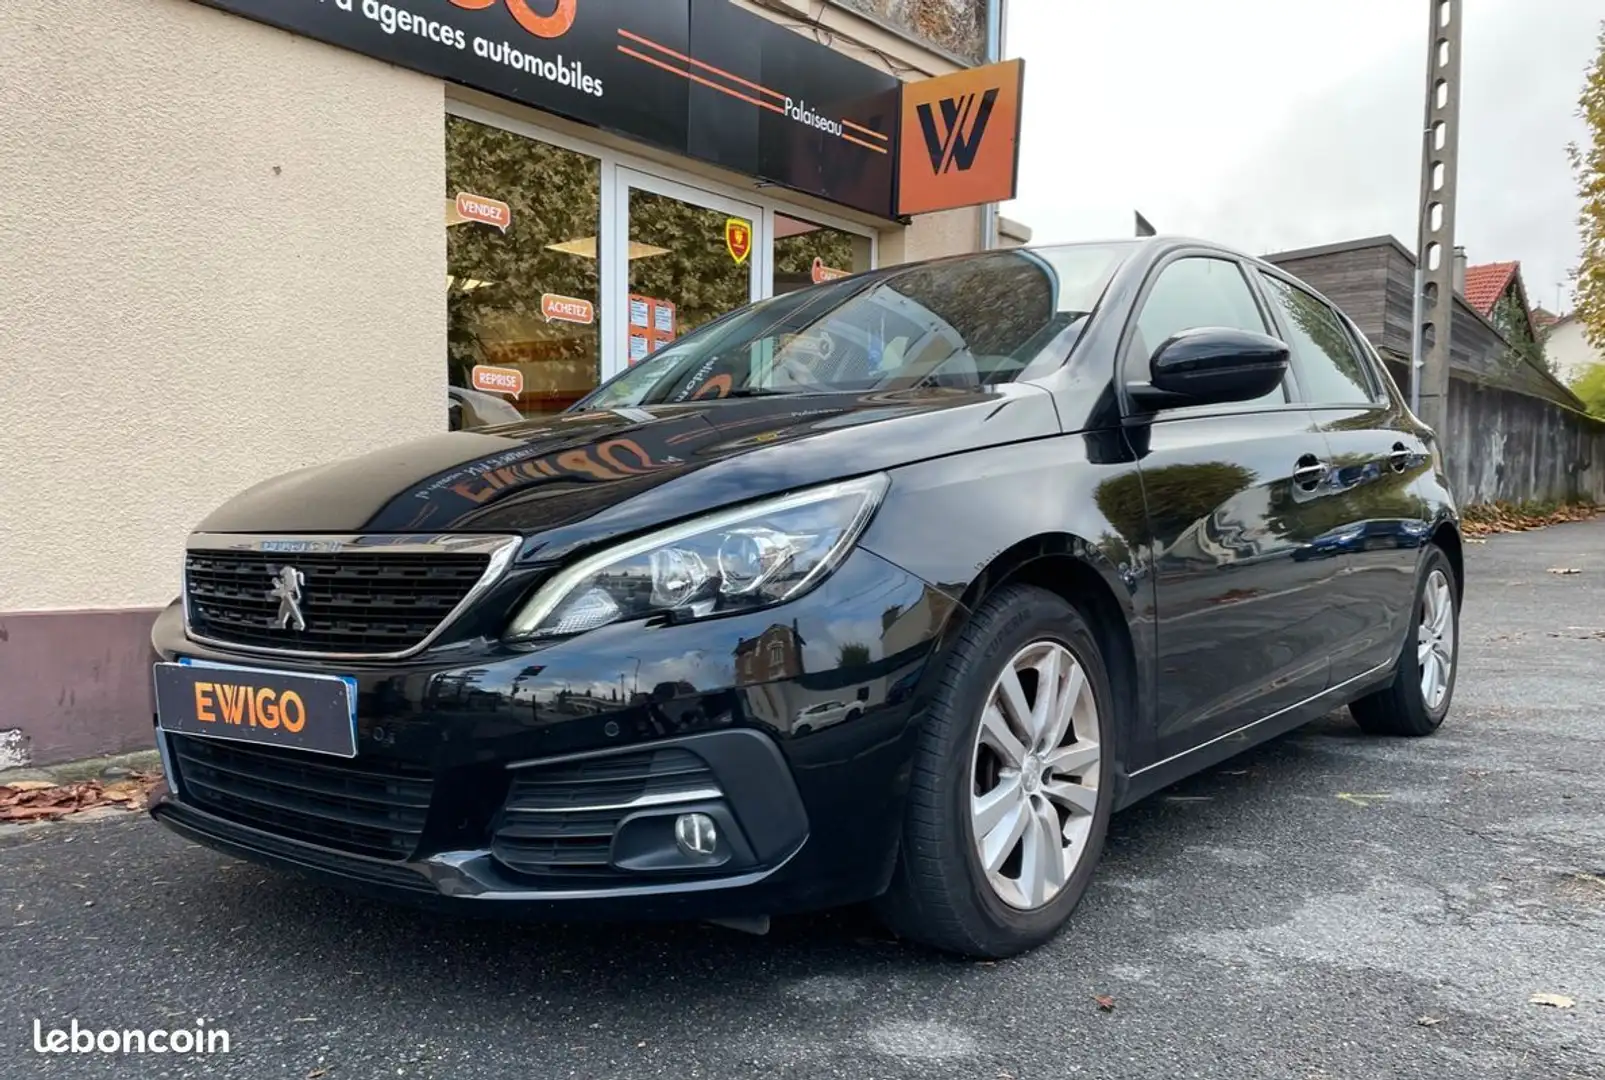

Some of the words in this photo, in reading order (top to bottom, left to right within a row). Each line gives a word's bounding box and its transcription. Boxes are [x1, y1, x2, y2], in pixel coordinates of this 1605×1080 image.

[473, 35, 604, 97] automobiles
[784, 97, 843, 138] Palaiseau
[460, 198, 503, 221] VENDEZ
[547, 300, 588, 318] ACHETEZ
[479, 373, 517, 389] REPRISE
[194, 681, 306, 733] EWIGO
